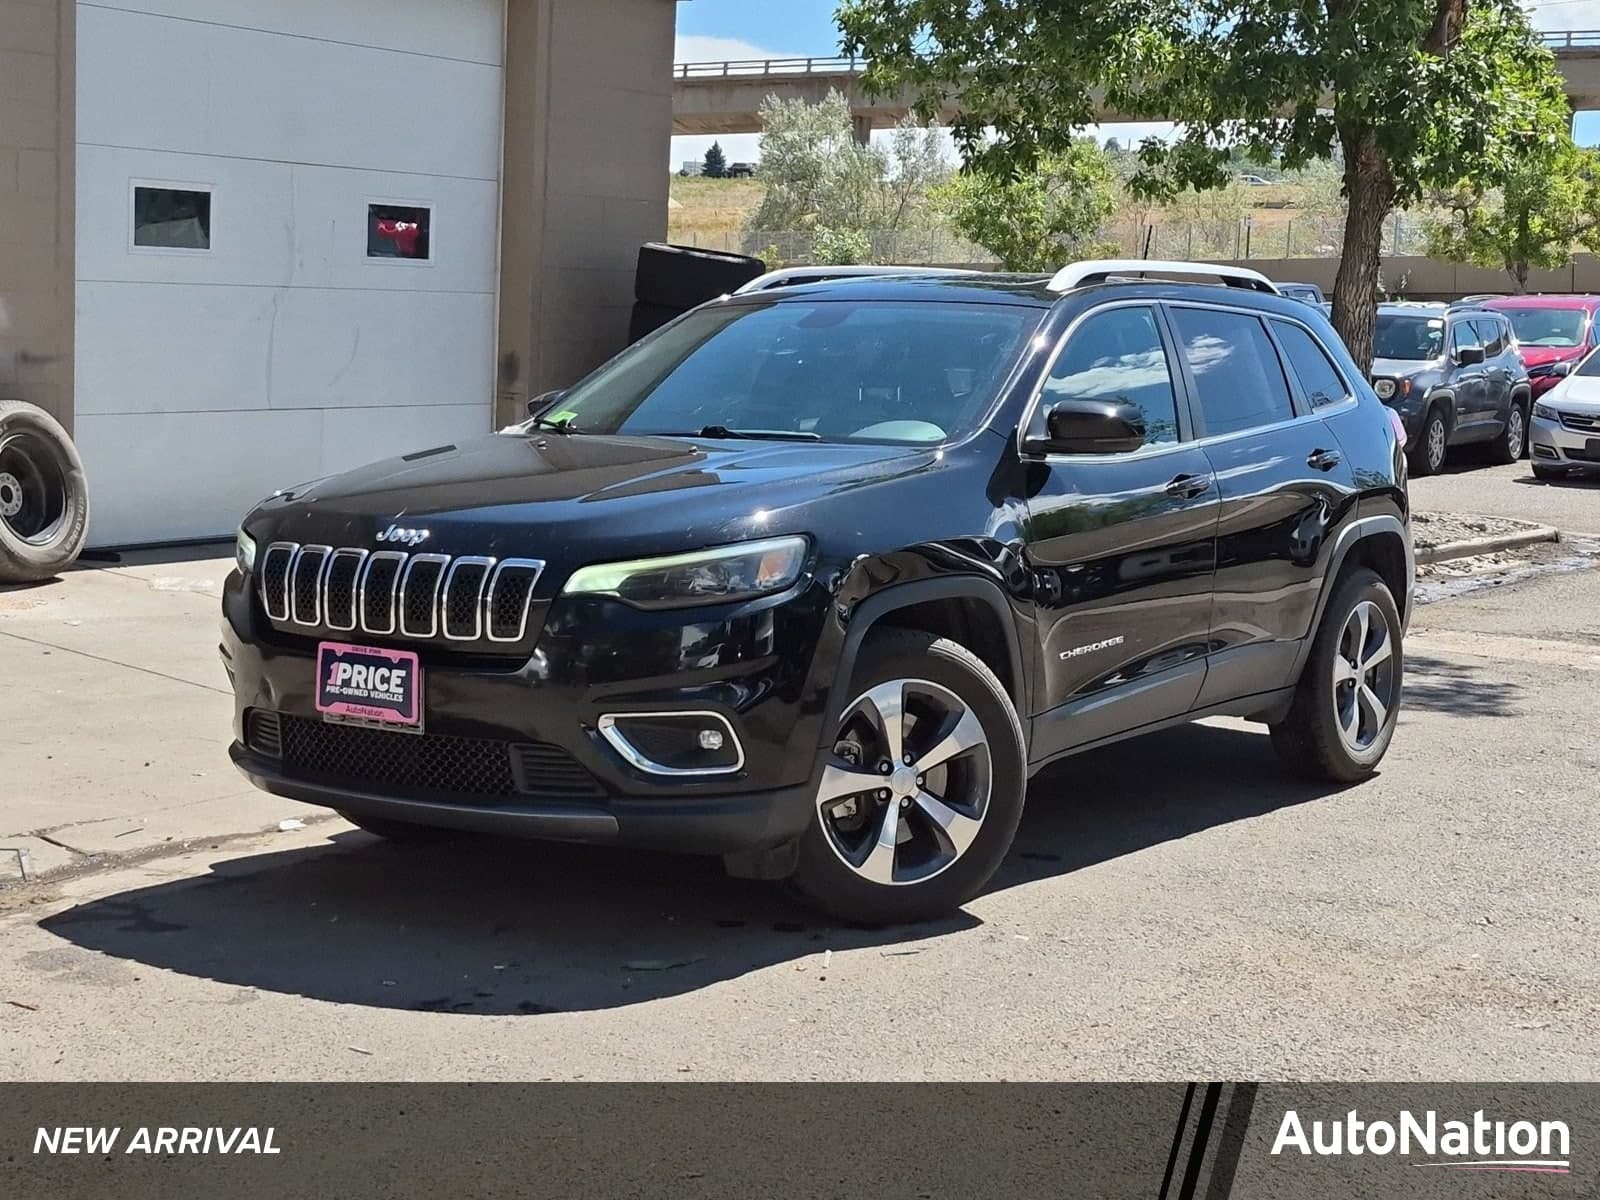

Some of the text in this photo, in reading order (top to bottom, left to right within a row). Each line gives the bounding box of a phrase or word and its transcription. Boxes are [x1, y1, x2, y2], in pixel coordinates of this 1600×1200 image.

[376, 524, 430, 546] Jeep
[1059, 636, 1124, 660] CHEROKEE
[326, 685, 404, 702] PRE-OWNED VEHICLES
